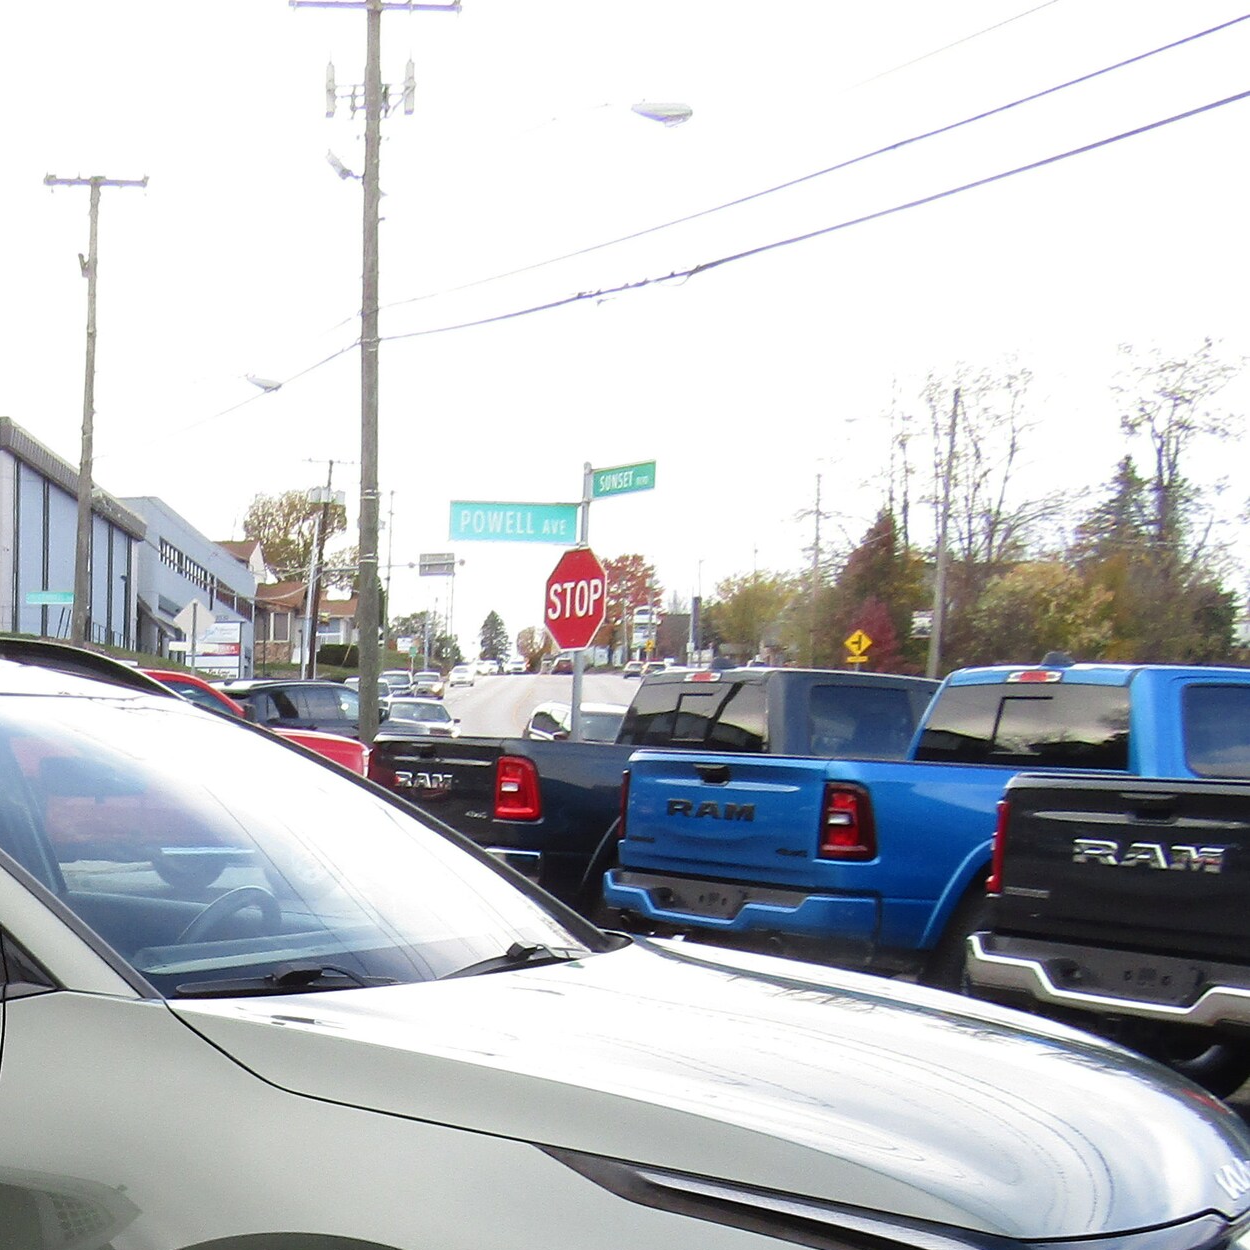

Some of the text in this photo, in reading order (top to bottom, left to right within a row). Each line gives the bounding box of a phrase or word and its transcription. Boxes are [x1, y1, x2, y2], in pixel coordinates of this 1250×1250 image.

[599, 470, 634, 492] SUNSET
[459, 509, 566, 535] POWELL AVE
[547, 578, 602, 620] STOP
[394, 770, 454, 791] RAM
[666, 798, 756, 822] RAM
[1072, 837, 1226, 874] RAM
